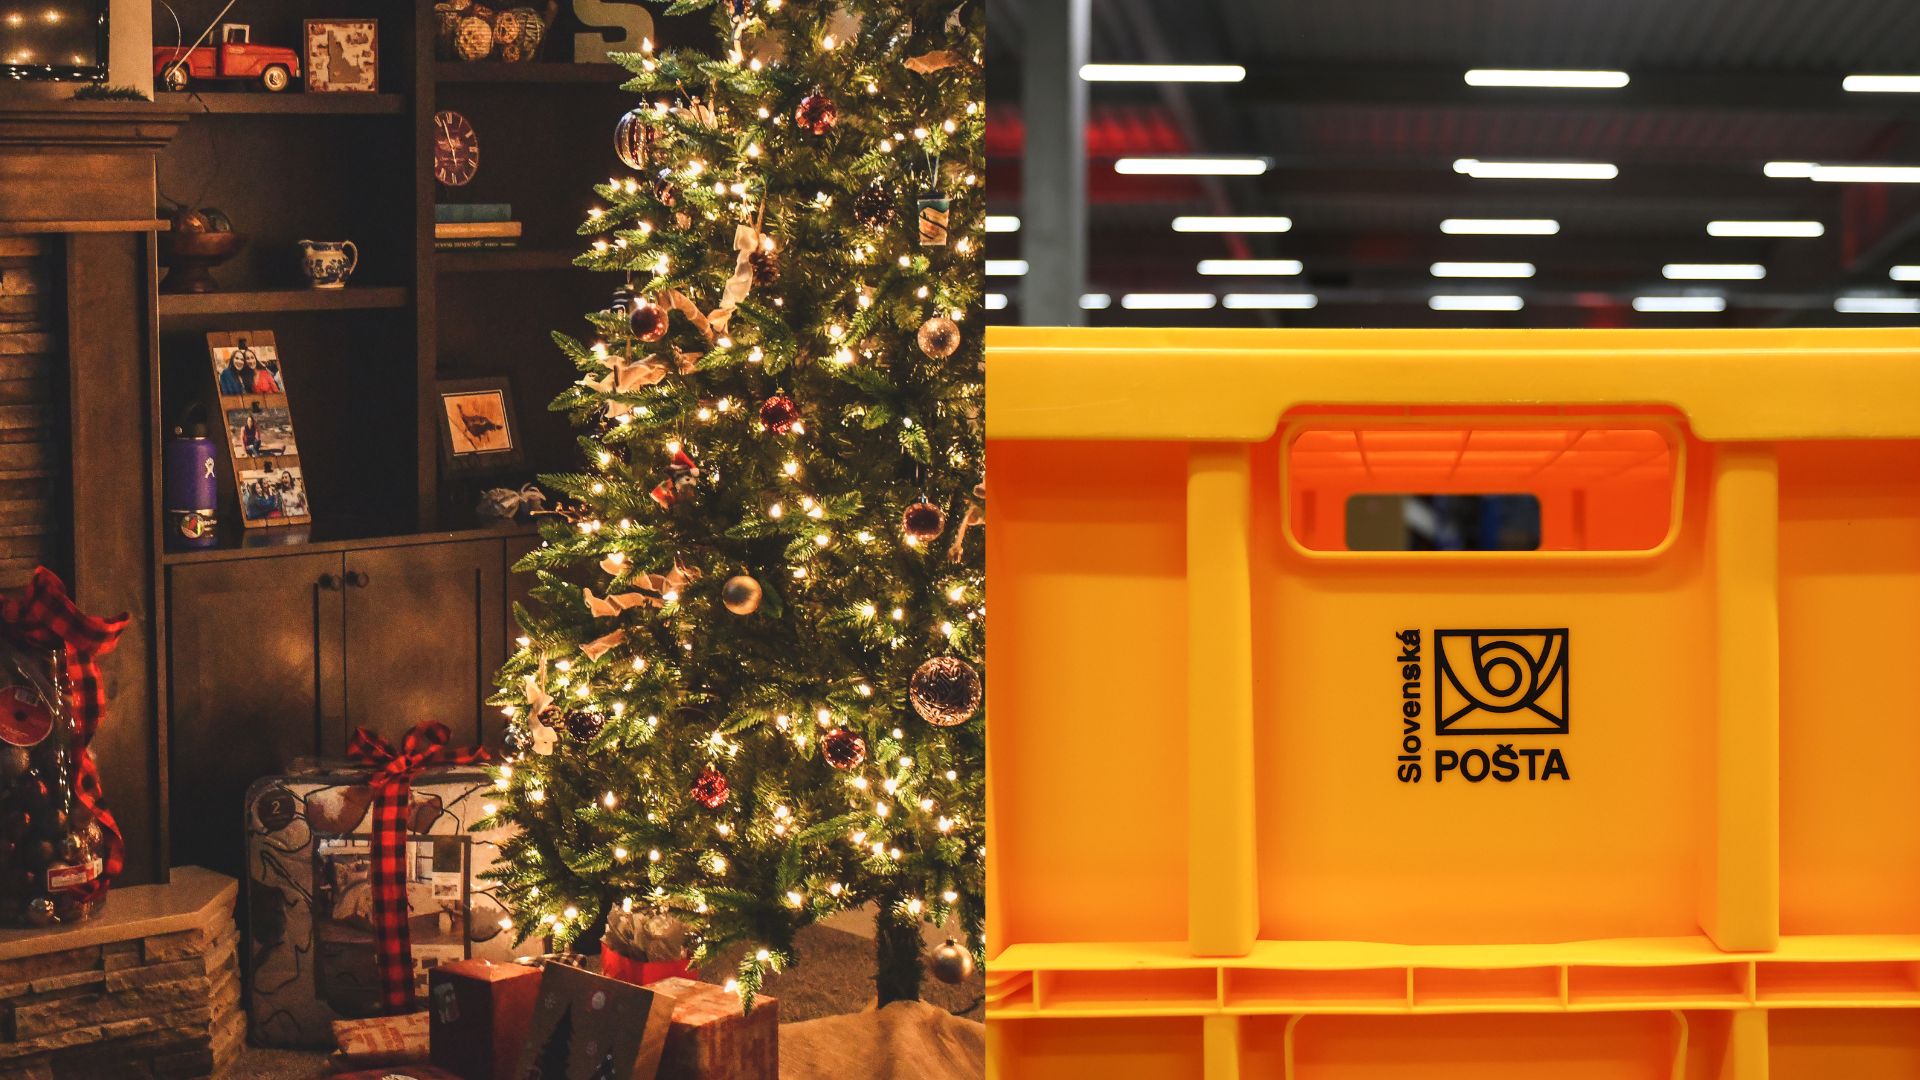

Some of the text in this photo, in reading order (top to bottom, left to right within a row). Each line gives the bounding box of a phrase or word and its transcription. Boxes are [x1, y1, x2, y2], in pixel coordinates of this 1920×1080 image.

[573, 0, 654, 63] S
[1396, 629, 1421, 783] Slovenská
[1435, 744, 1571, 783] POŠTA
